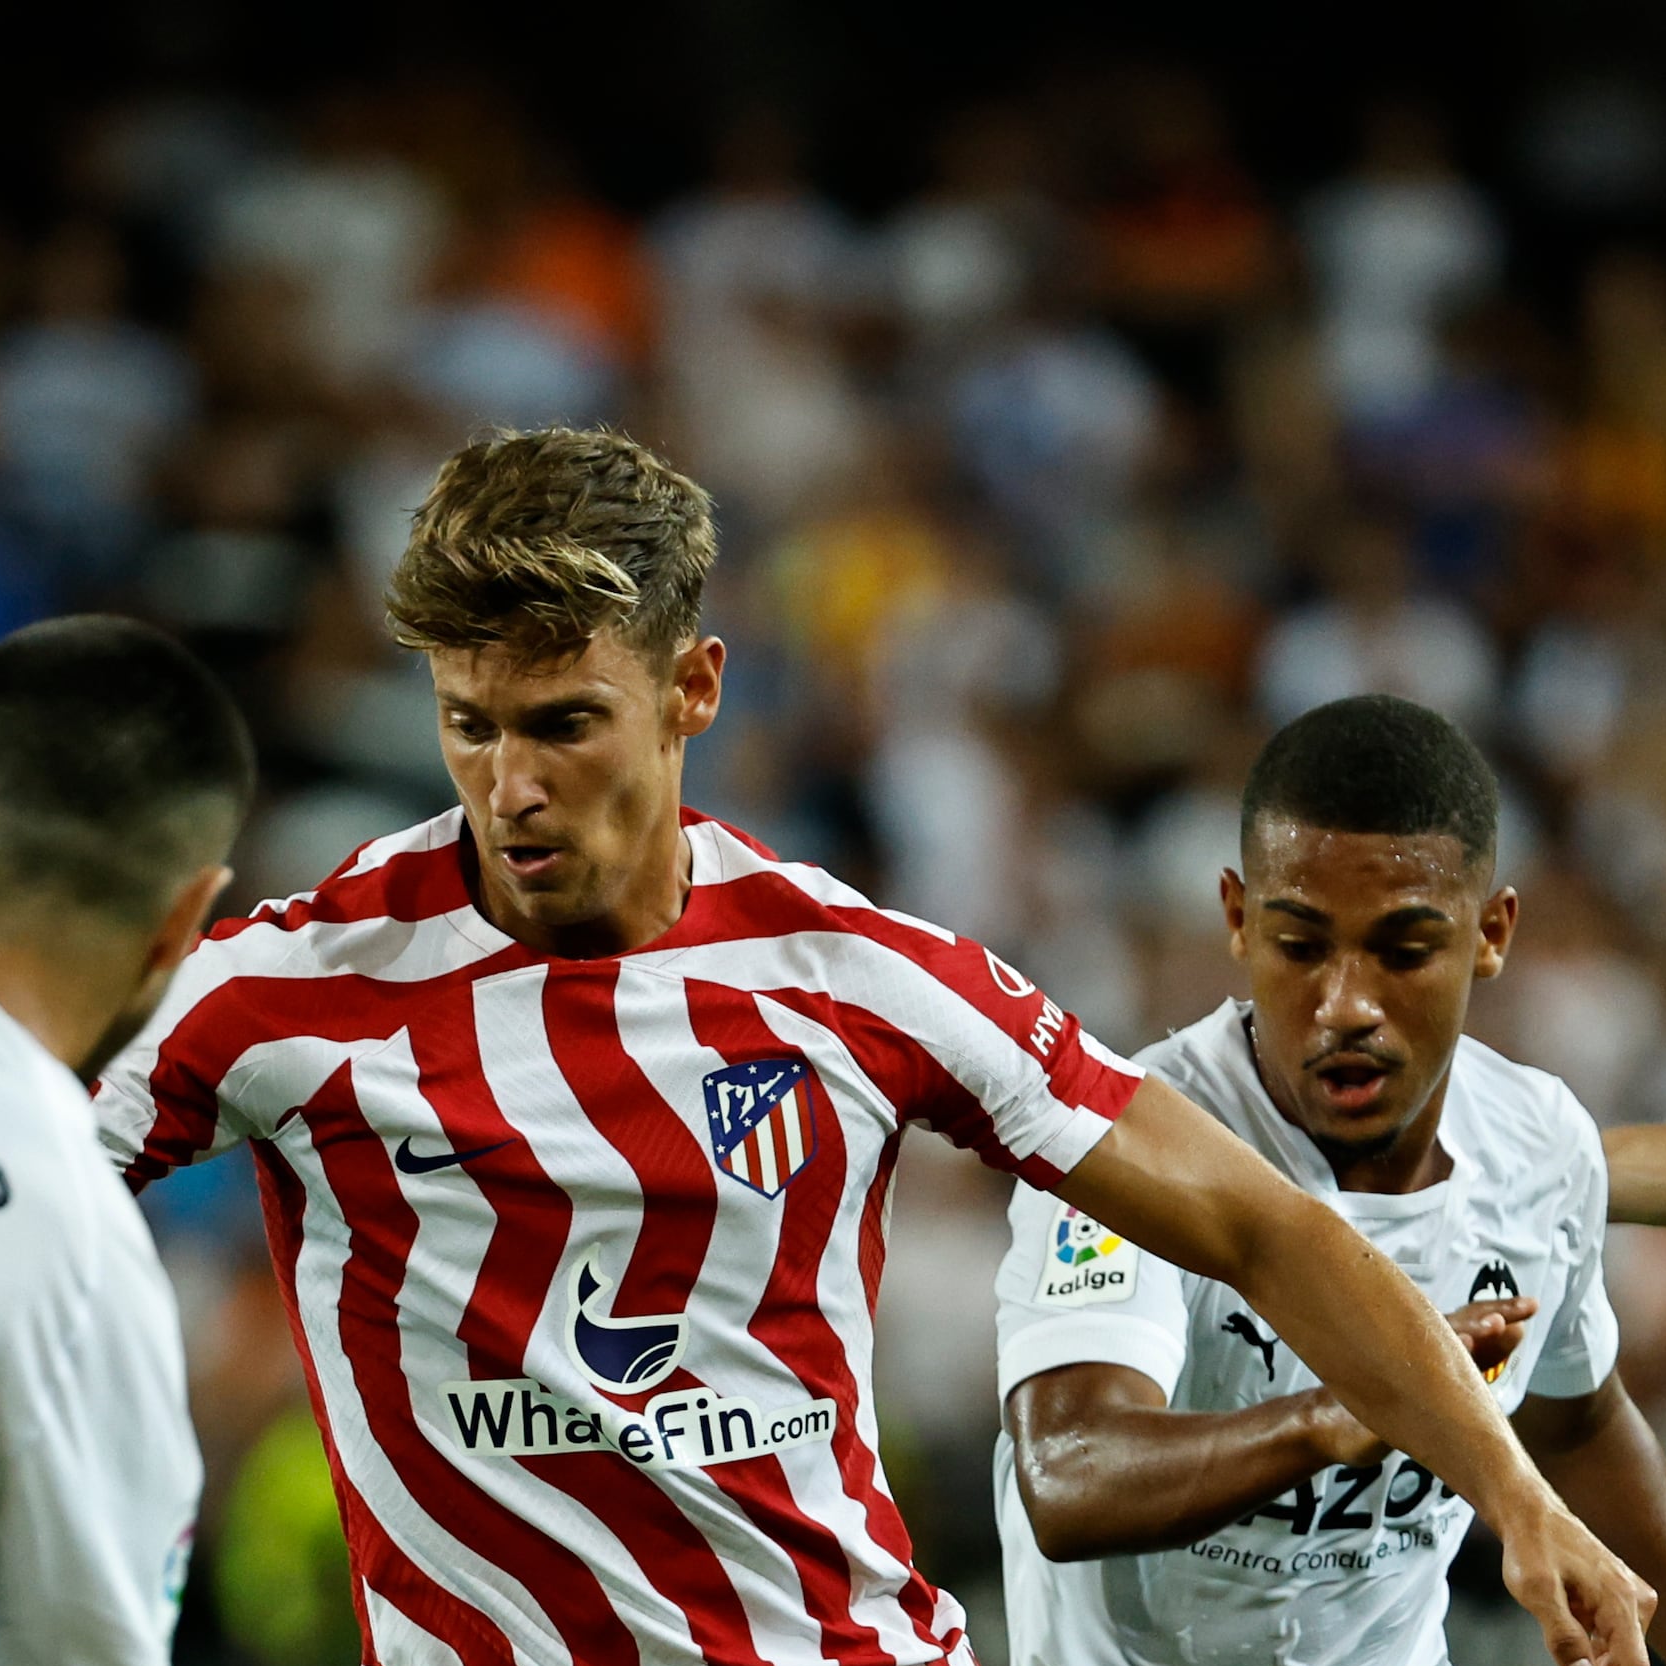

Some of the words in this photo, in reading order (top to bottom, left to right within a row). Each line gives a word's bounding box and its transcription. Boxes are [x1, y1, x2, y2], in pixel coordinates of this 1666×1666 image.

[1030, 994, 1065, 1057] HYU
[1046, 1268, 1126, 1296] LaLiga
[447, 1391, 830, 1464] WhaeFin.com
[1236, 1459, 1456, 1536] AZO
[1190, 1543, 1285, 1574] uentra.
[1291, 1541, 1393, 1574] Condue.
